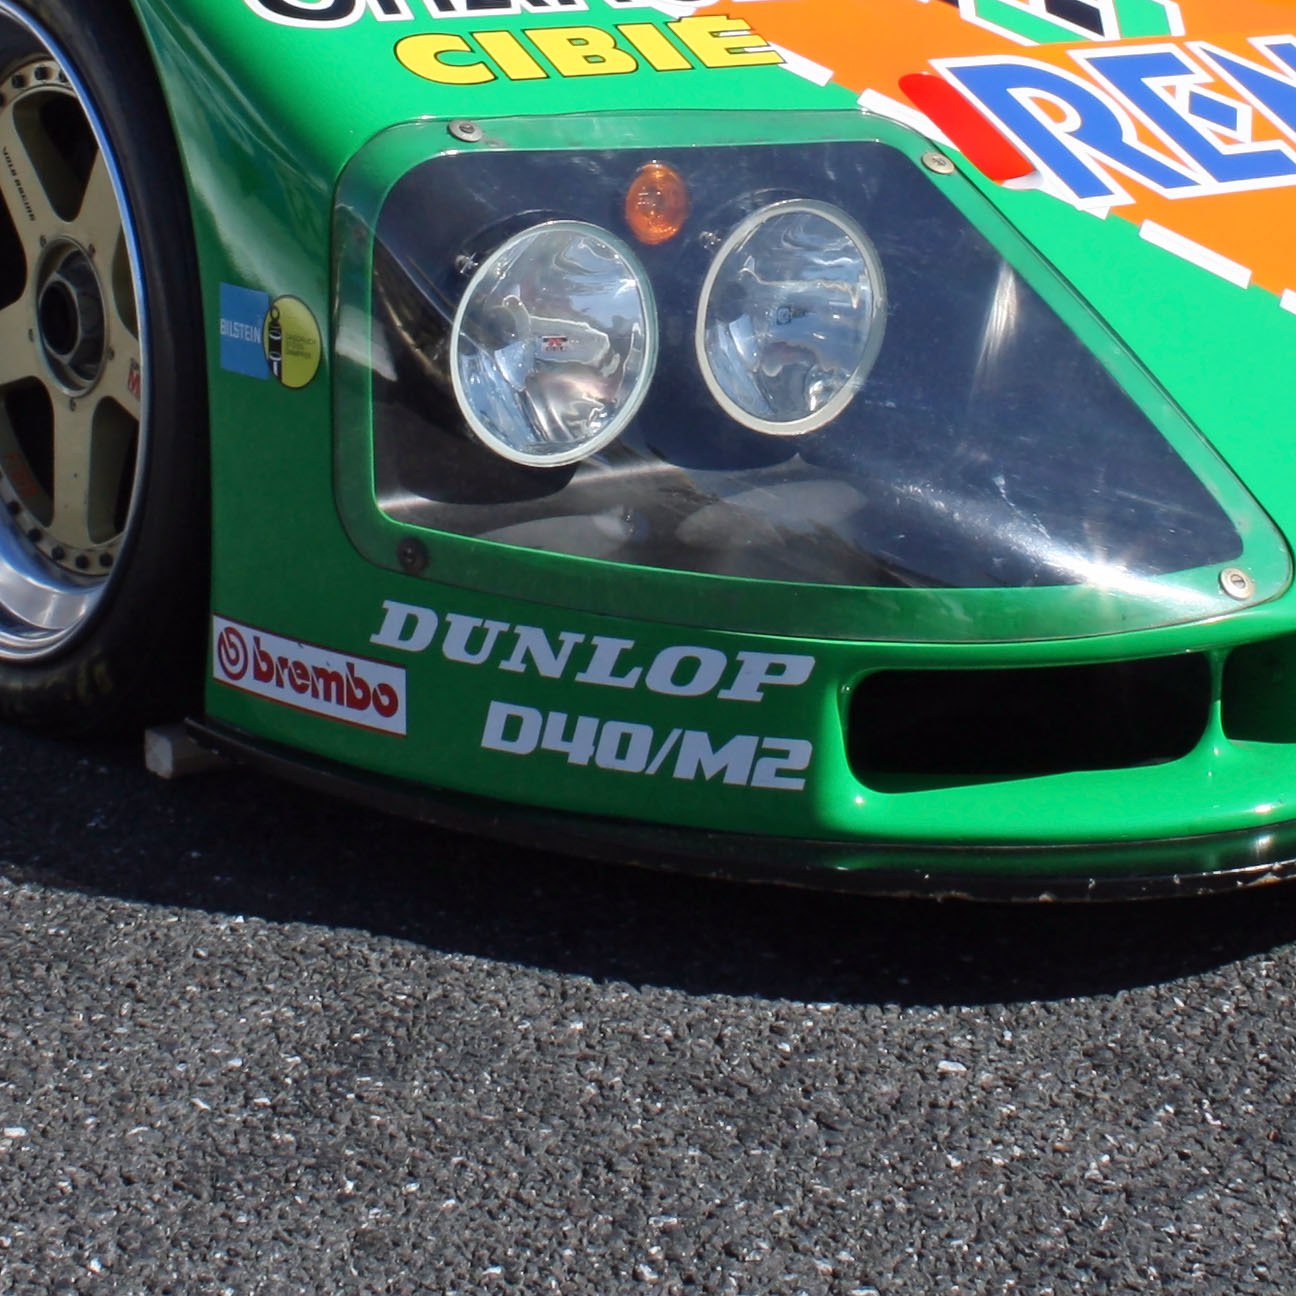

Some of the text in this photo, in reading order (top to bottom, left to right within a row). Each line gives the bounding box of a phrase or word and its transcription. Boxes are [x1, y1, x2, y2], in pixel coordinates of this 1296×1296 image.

[219, 318, 263, 345] BILSTEIN
[251, 634, 401, 718] brembo
[369, 599, 816, 704] DUNLOP
[480, 700, 814, 792] D40/M2
